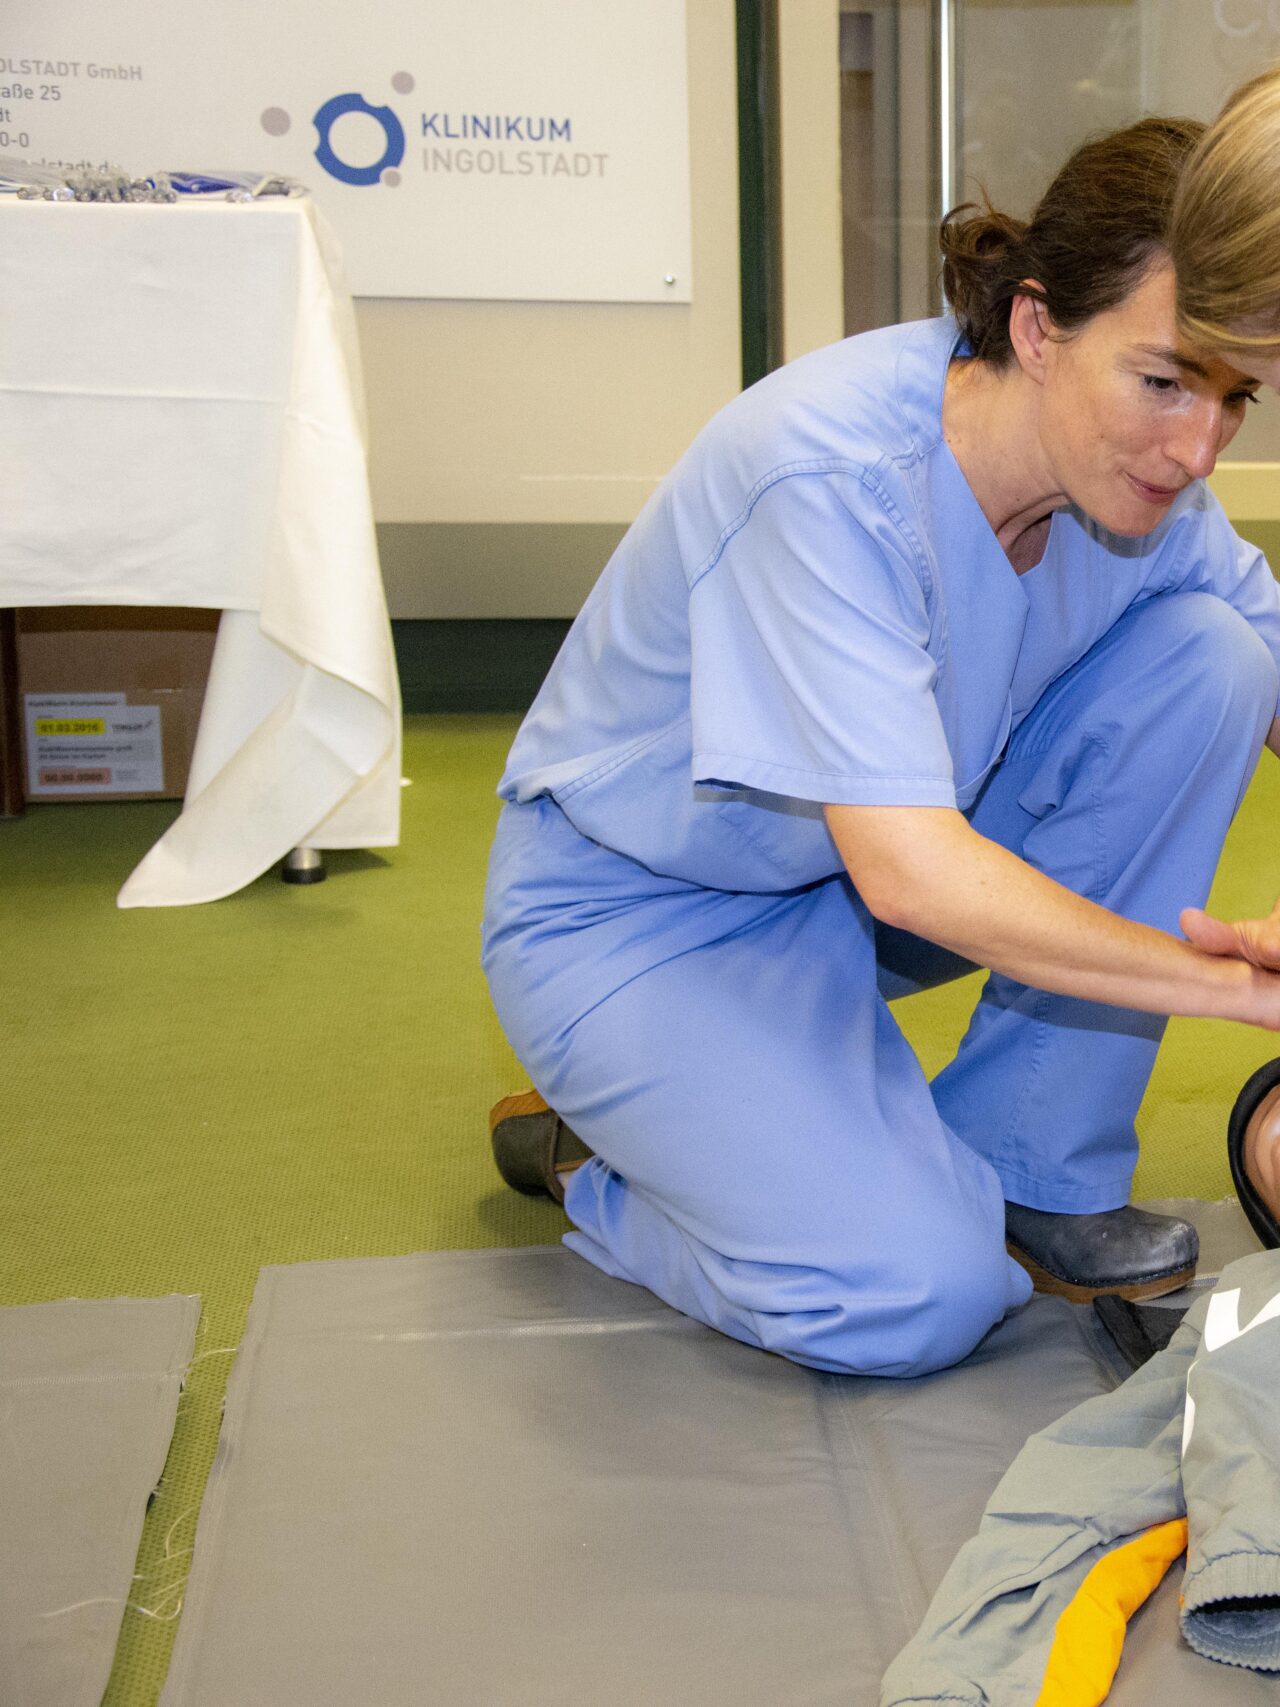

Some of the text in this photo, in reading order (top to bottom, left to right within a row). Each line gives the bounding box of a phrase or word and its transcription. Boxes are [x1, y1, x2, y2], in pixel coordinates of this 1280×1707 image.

[87, 63, 142, 80] GmbH
[40, 85, 61, 101] 25
[421, 113, 571, 142] KLINIKUM
[422, 147, 609, 178] INGOLSTADT
